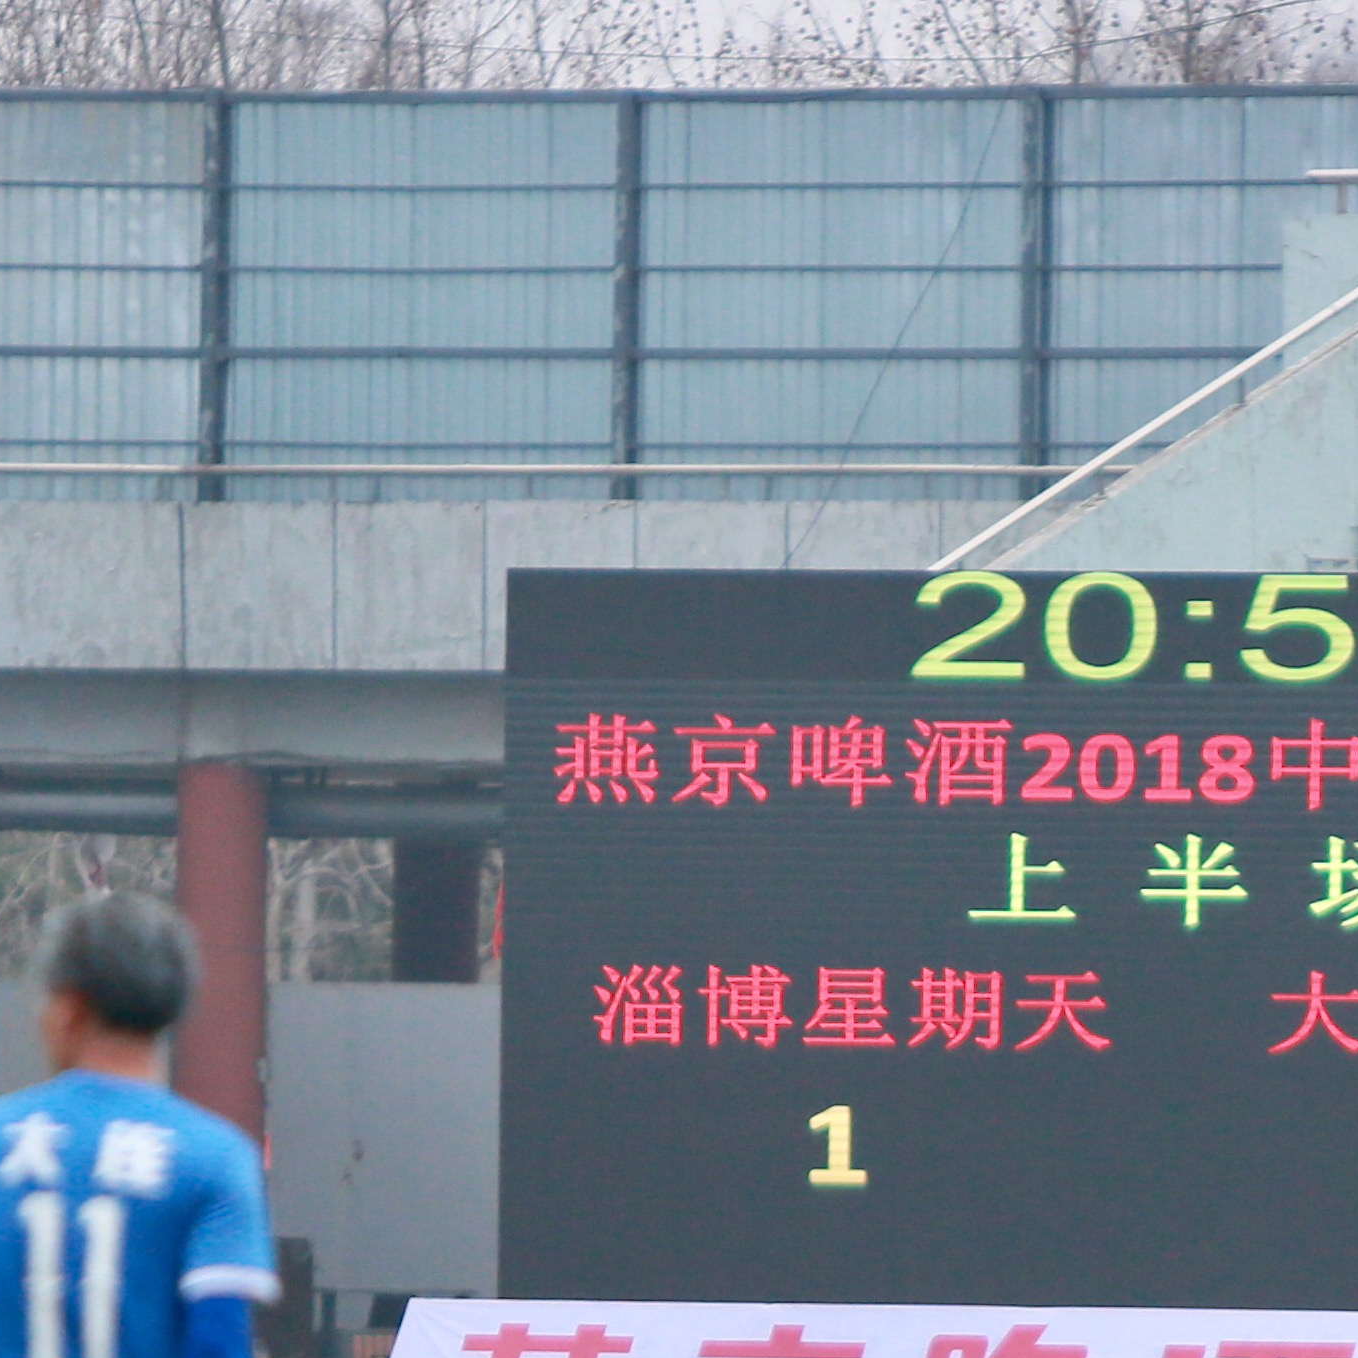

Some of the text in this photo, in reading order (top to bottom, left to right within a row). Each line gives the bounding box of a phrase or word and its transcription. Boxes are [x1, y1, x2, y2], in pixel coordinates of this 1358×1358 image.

[592, 963, 1113, 1053] 淄博星期天
[808, 1104, 868, 1188] 1
